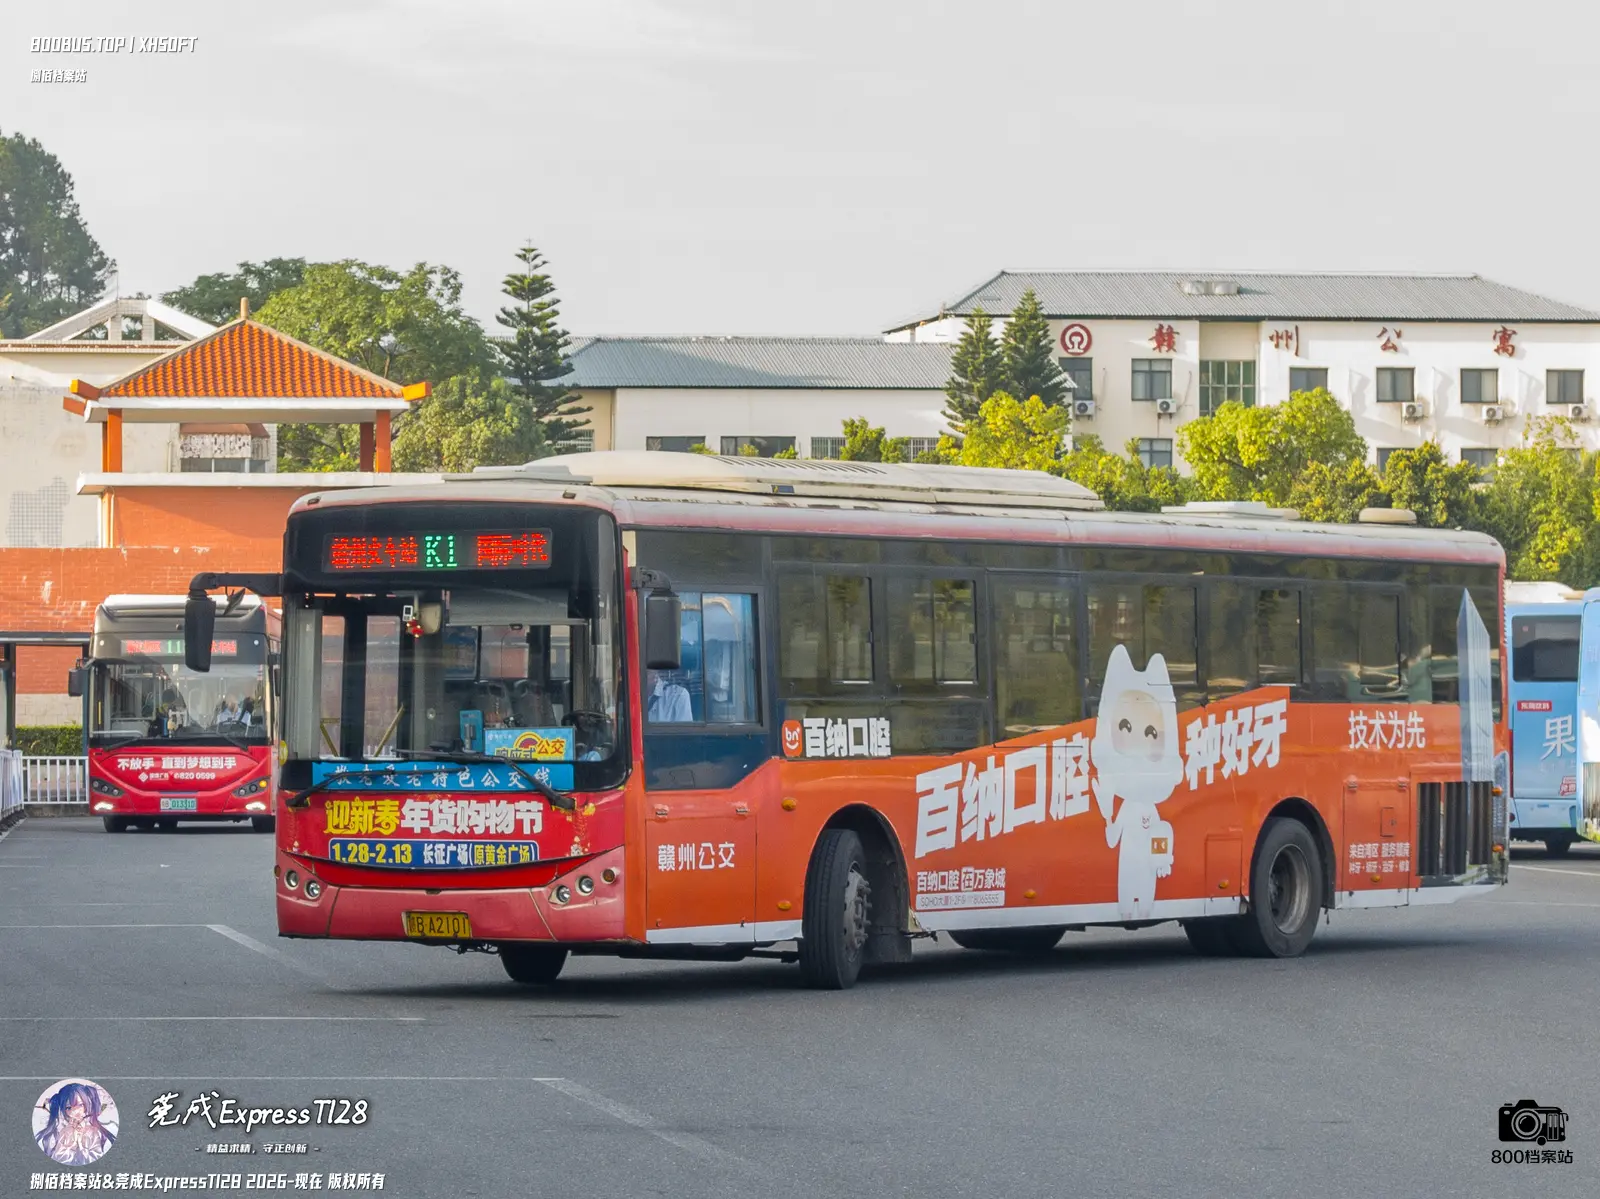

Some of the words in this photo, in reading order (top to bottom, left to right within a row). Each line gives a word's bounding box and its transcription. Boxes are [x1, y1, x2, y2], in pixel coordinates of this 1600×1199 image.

[424, 535, 458, 568] K1
[803, 717, 892, 758] 百纳口腔
[1348, 709, 1426, 750] 技术为先
[537, 738, 566, 755] 公交
[117, 757, 155, 771] 不放手
[161, 756, 237, 770] 直到梦想到手
[914, 731, 1091, 860] 百纳口腔
[1184, 698, 1287, 791] 种好牙
[331, 842, 413, 864] 1.28-2.13
[658, 842, 735, 871] 赣州公交
